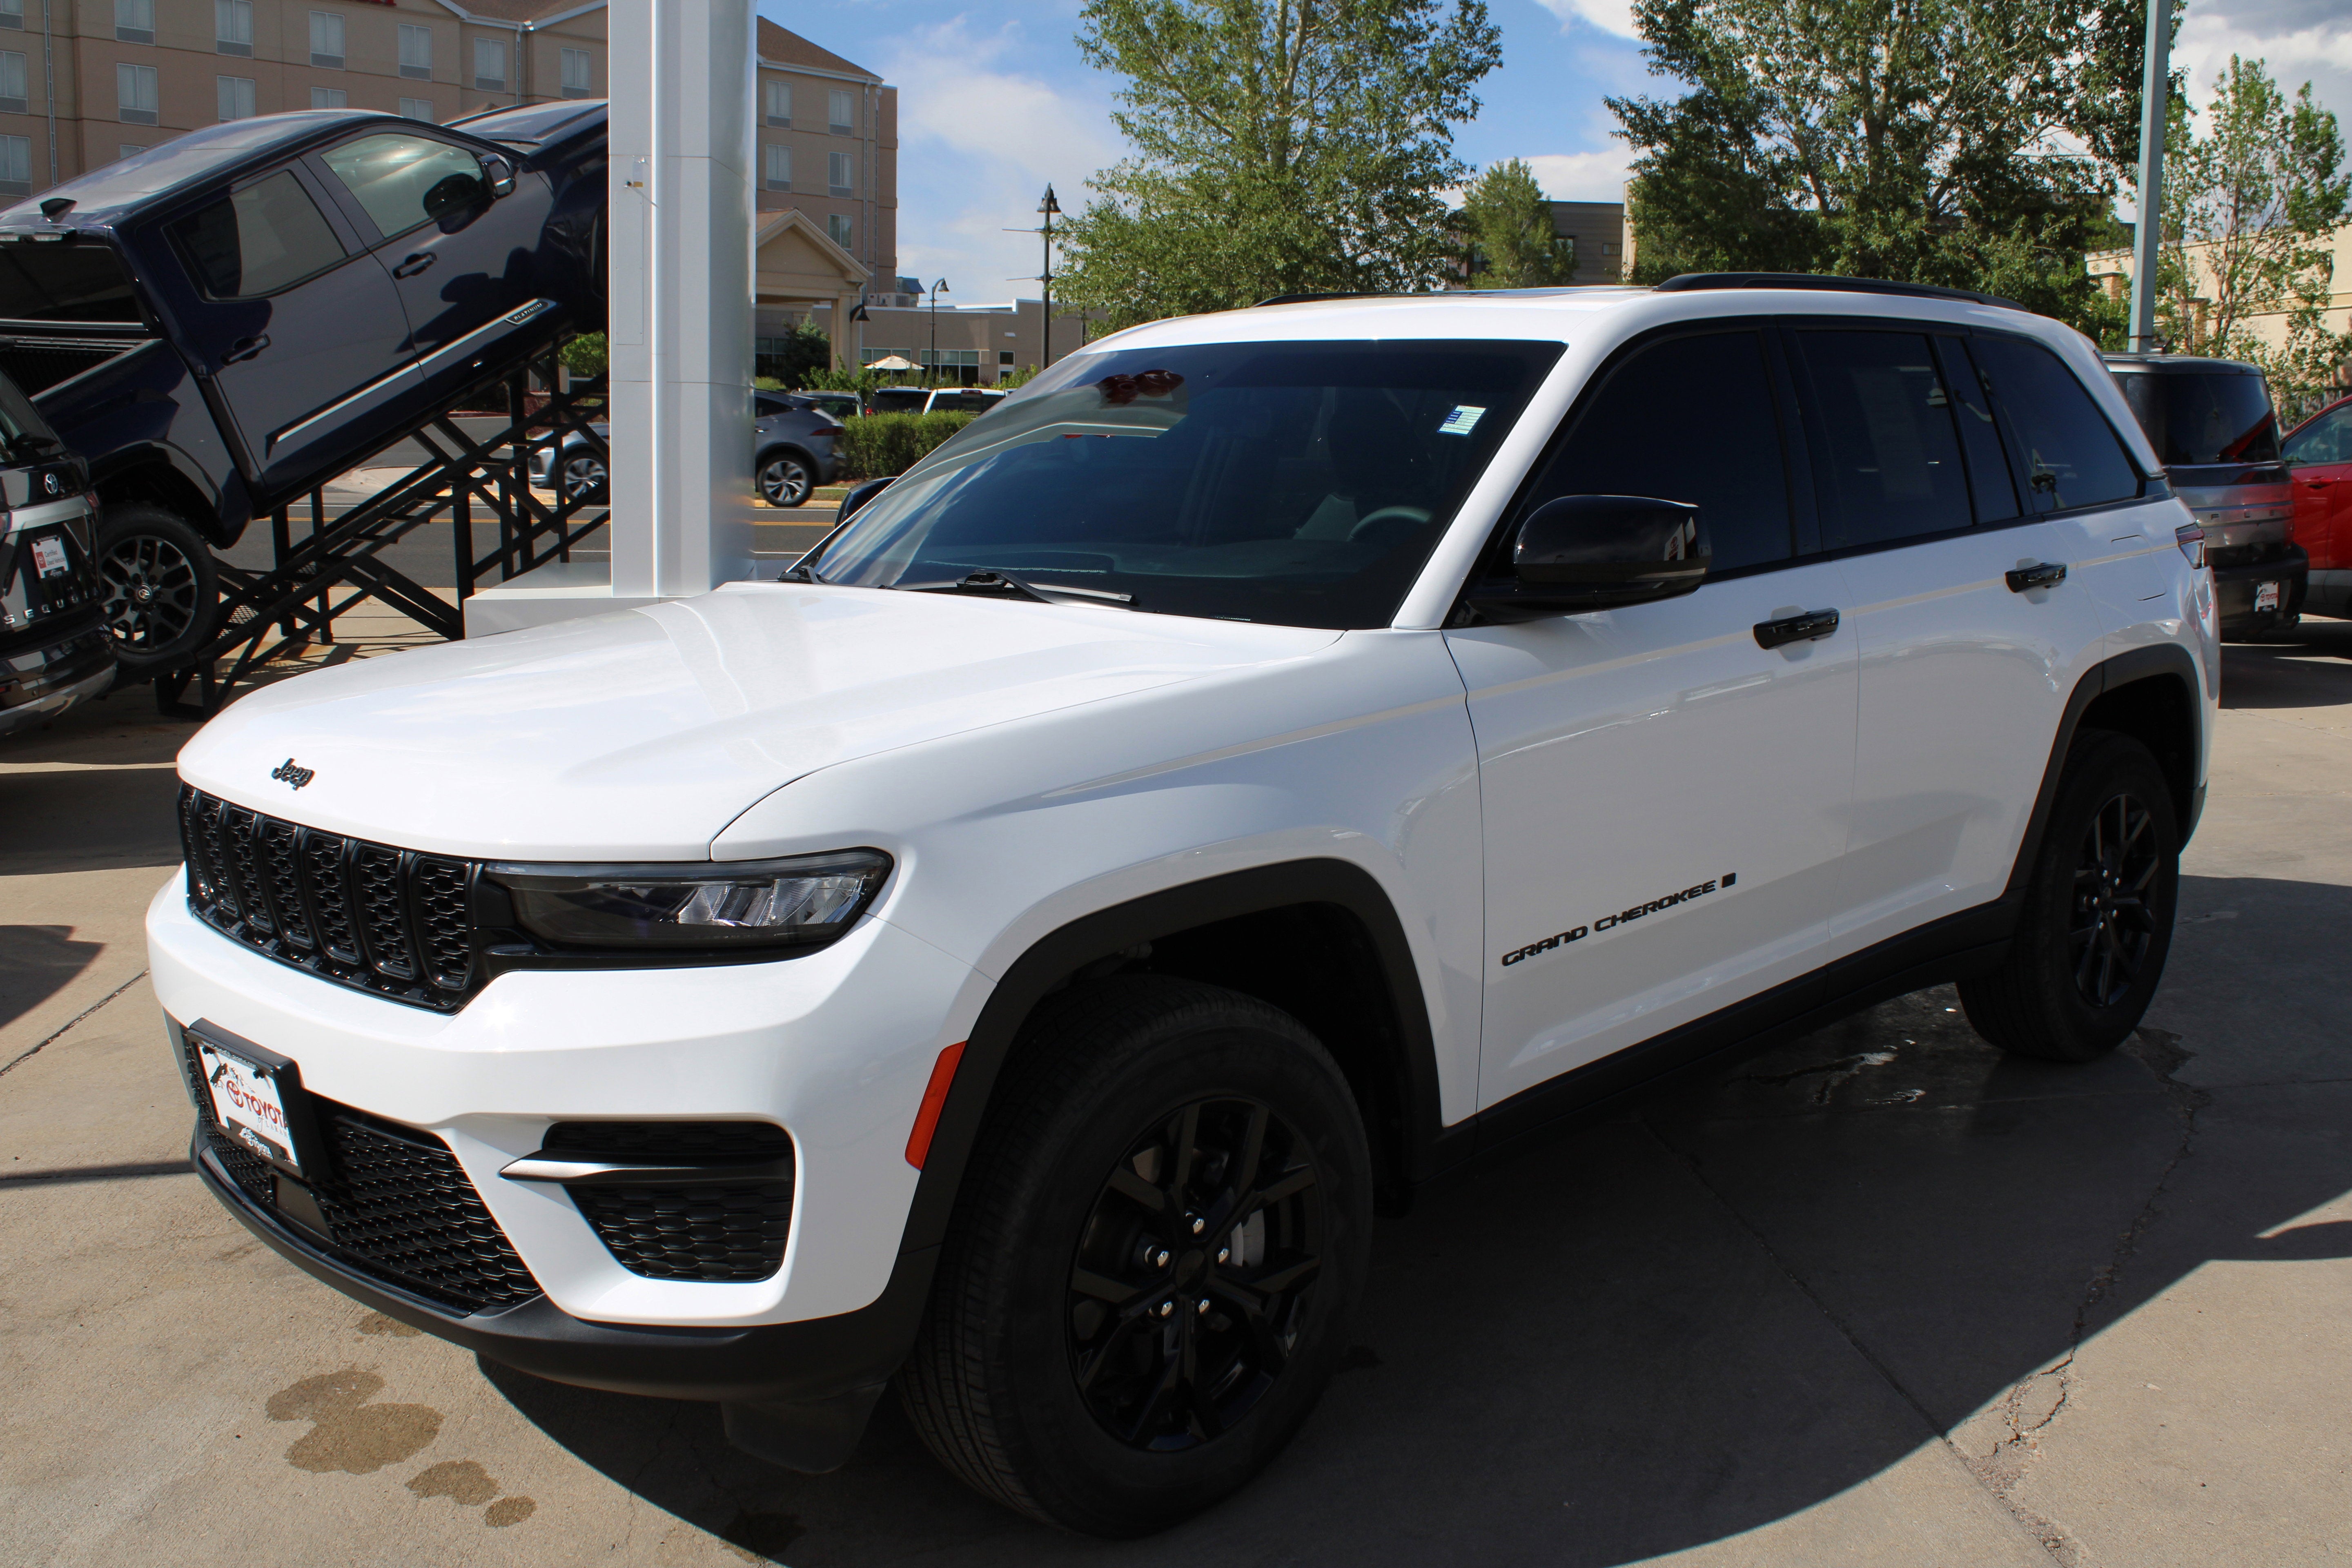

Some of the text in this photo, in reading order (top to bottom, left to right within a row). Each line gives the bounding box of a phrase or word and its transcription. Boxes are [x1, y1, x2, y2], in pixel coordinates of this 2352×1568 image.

[514, 302, 543, 321] PLATINUM
[271, 757, 314, 791] Jeep
[1502, 880, 1716, 967] GRAND CHEROKEE
